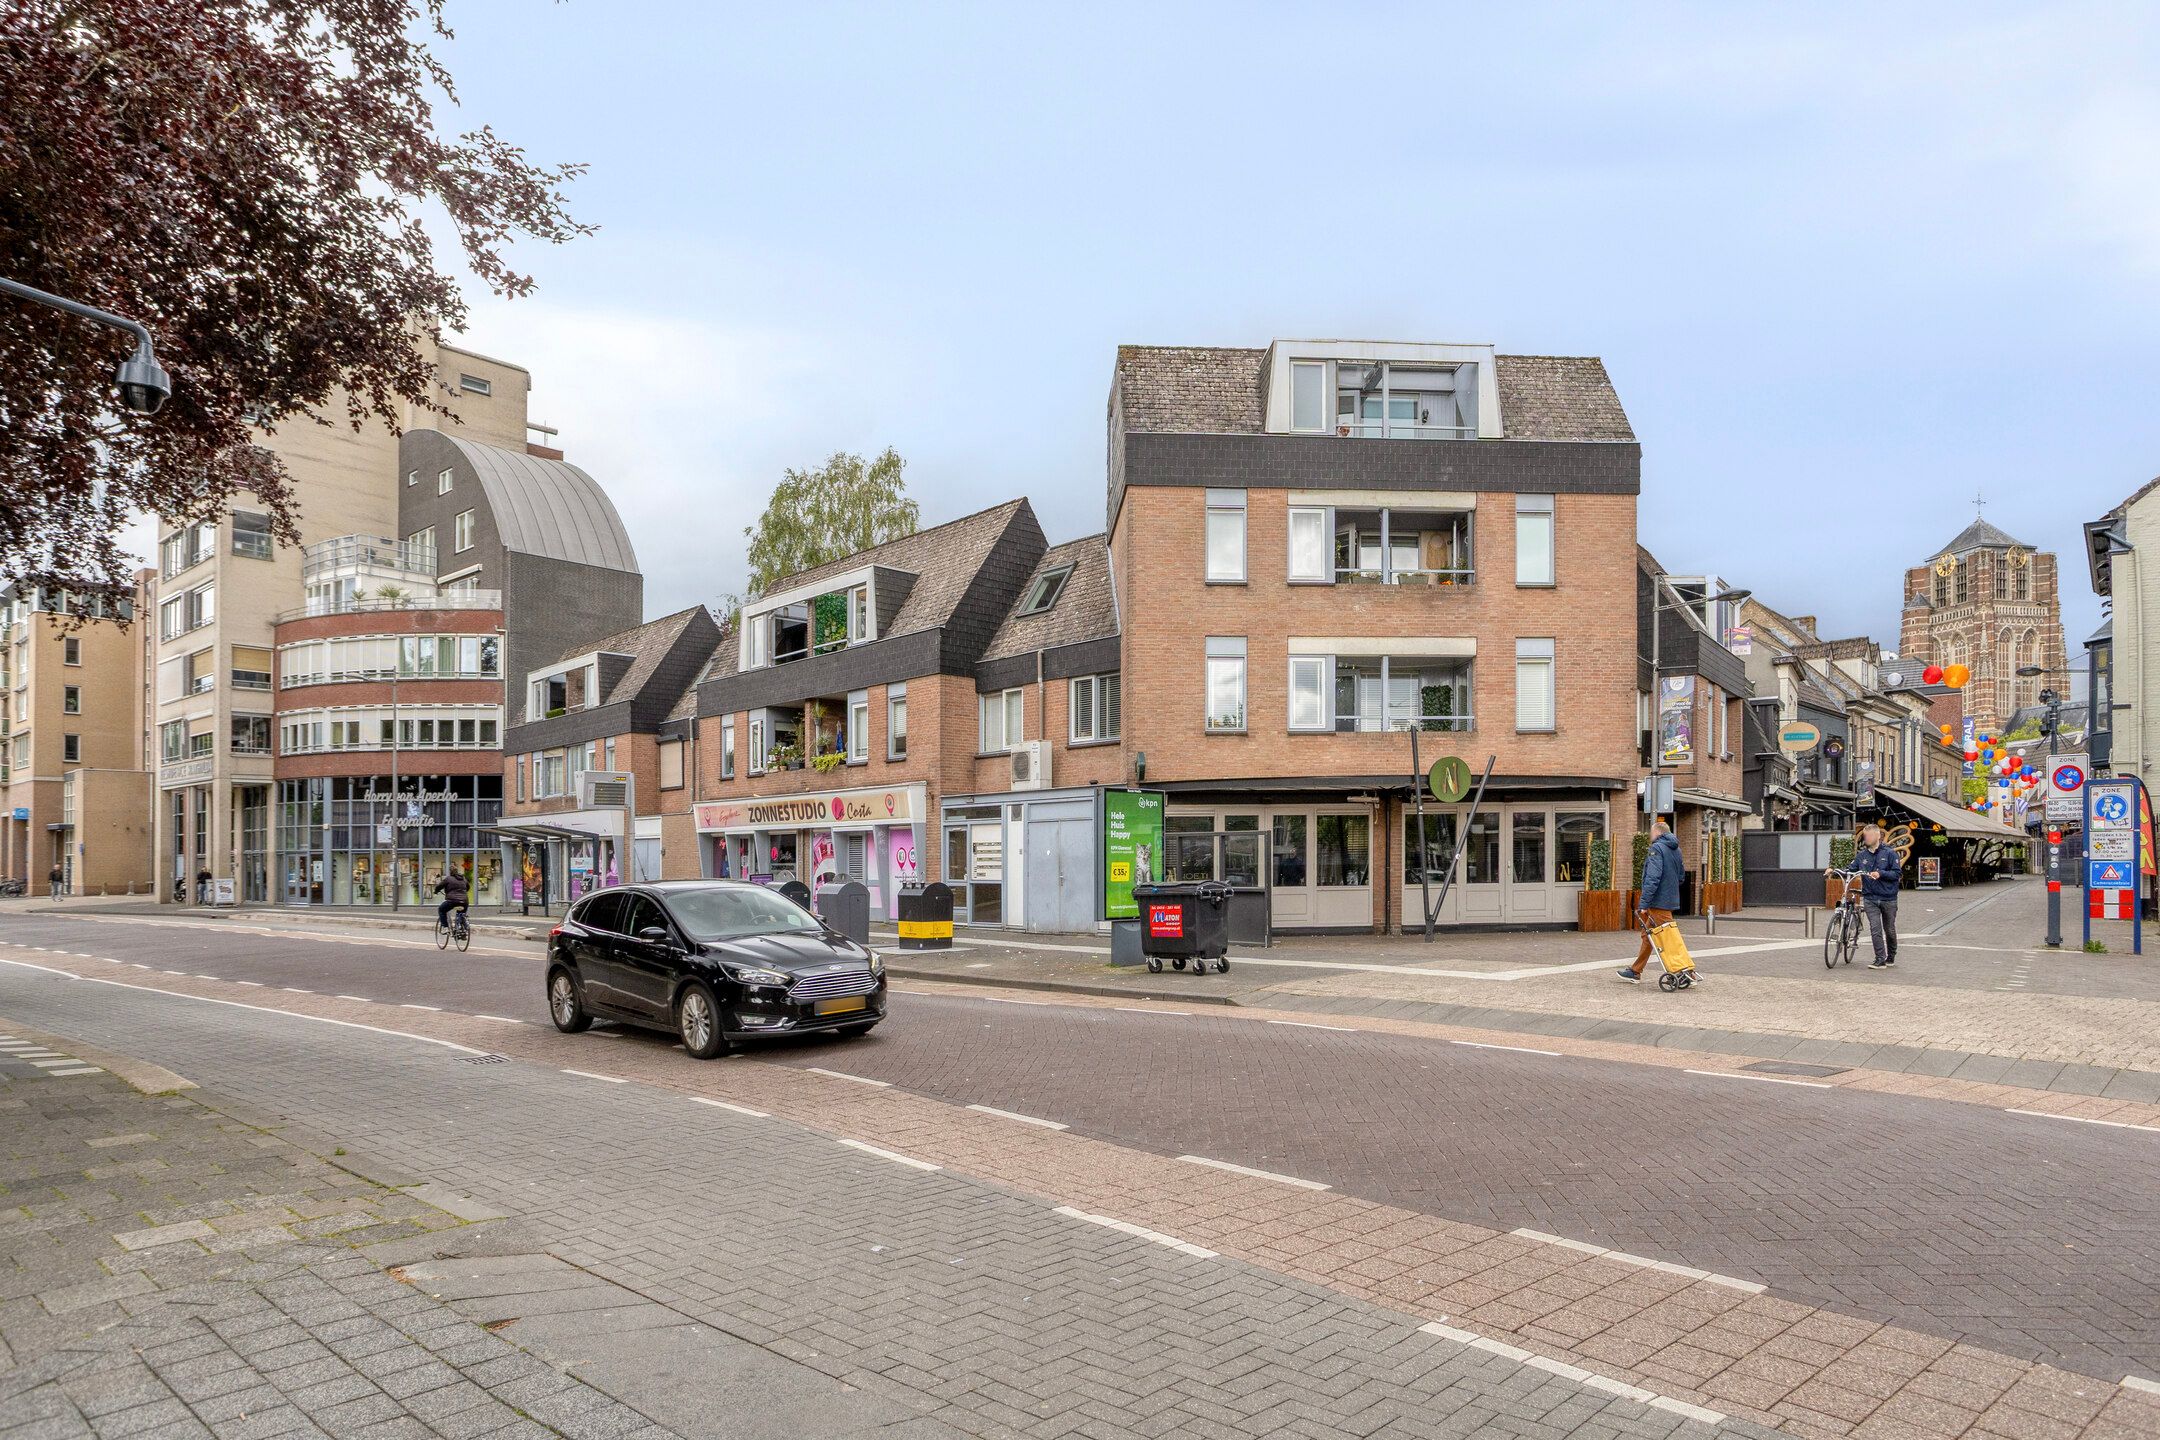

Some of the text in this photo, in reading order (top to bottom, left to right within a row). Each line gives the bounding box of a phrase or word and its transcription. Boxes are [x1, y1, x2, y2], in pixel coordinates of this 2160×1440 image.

[363, 789, 393, 807] Harry
[416, 788, 459, 807] Aperloo
[1145, 799, 1158, 809] kpn
[748, 801, 826, 823] ZONNESTUDIO
[847, 801, 872, 820] Costa
[1111, 811, 1125, 820] Hele
[381, 814, 435, 832] Foografie
[1111, 821, 1125, 829] Huis
[1111, 830, 1130, 840] Happy
